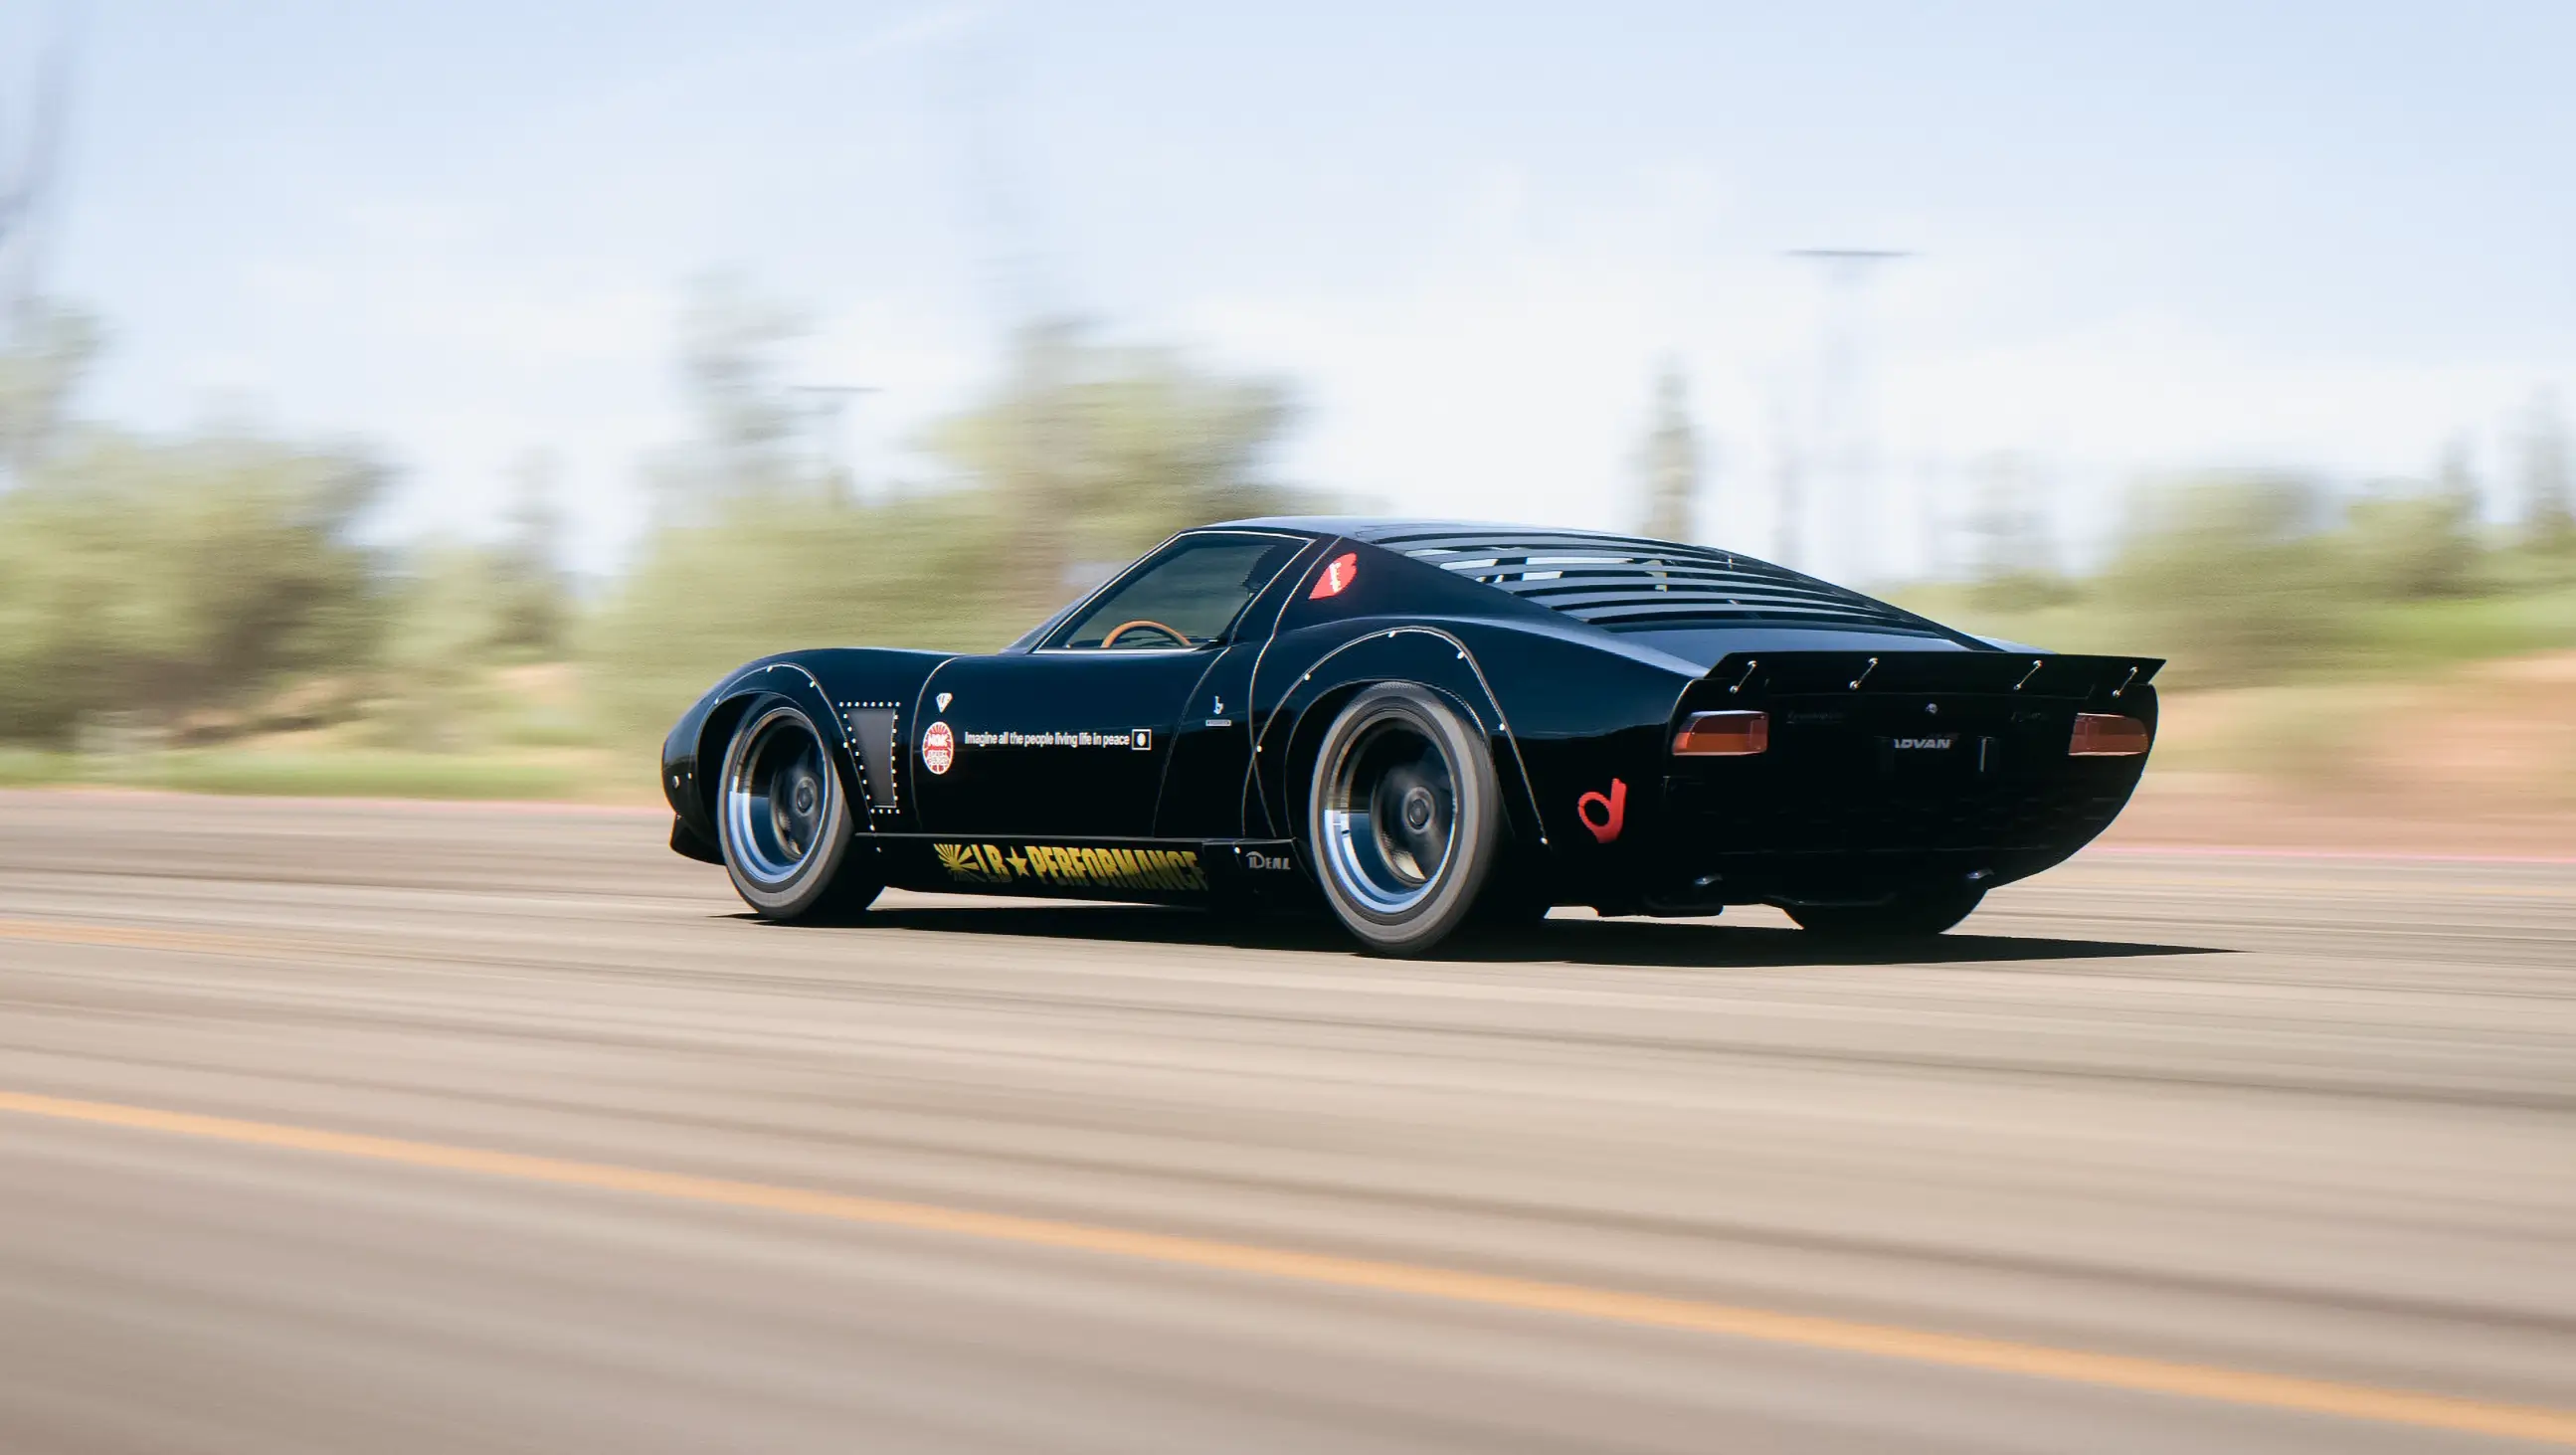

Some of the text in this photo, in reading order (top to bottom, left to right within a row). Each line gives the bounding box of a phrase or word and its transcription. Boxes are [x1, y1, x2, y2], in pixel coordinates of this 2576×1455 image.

[964, 731, 1130, 749] Imagine all the people living life in peace
[1023, 844, 1209, 892] PERFORMANCE
